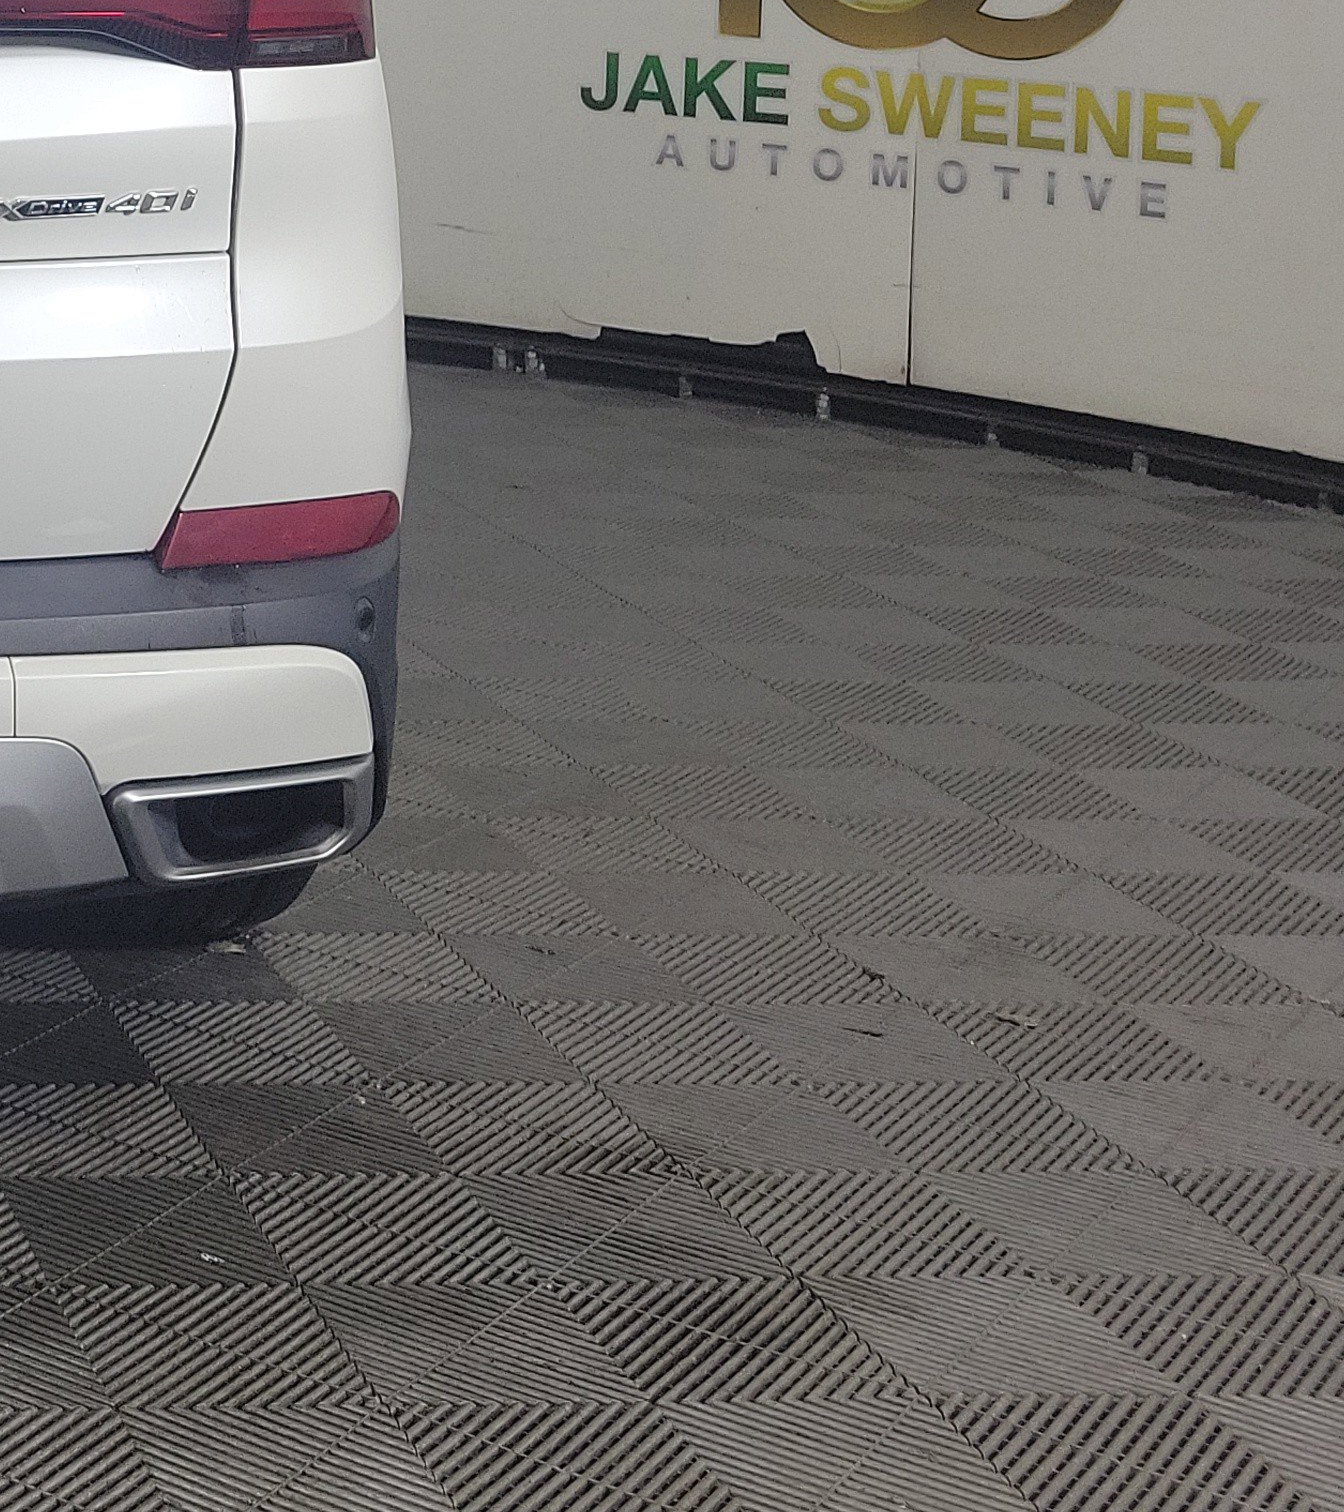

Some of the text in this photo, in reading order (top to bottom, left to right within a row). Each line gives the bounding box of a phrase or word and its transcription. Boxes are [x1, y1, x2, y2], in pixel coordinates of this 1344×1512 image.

[580, 52, 1262, 172] JAKE SWEENEY
[655, 134, 1168, 219] AUTOMOTIVE
